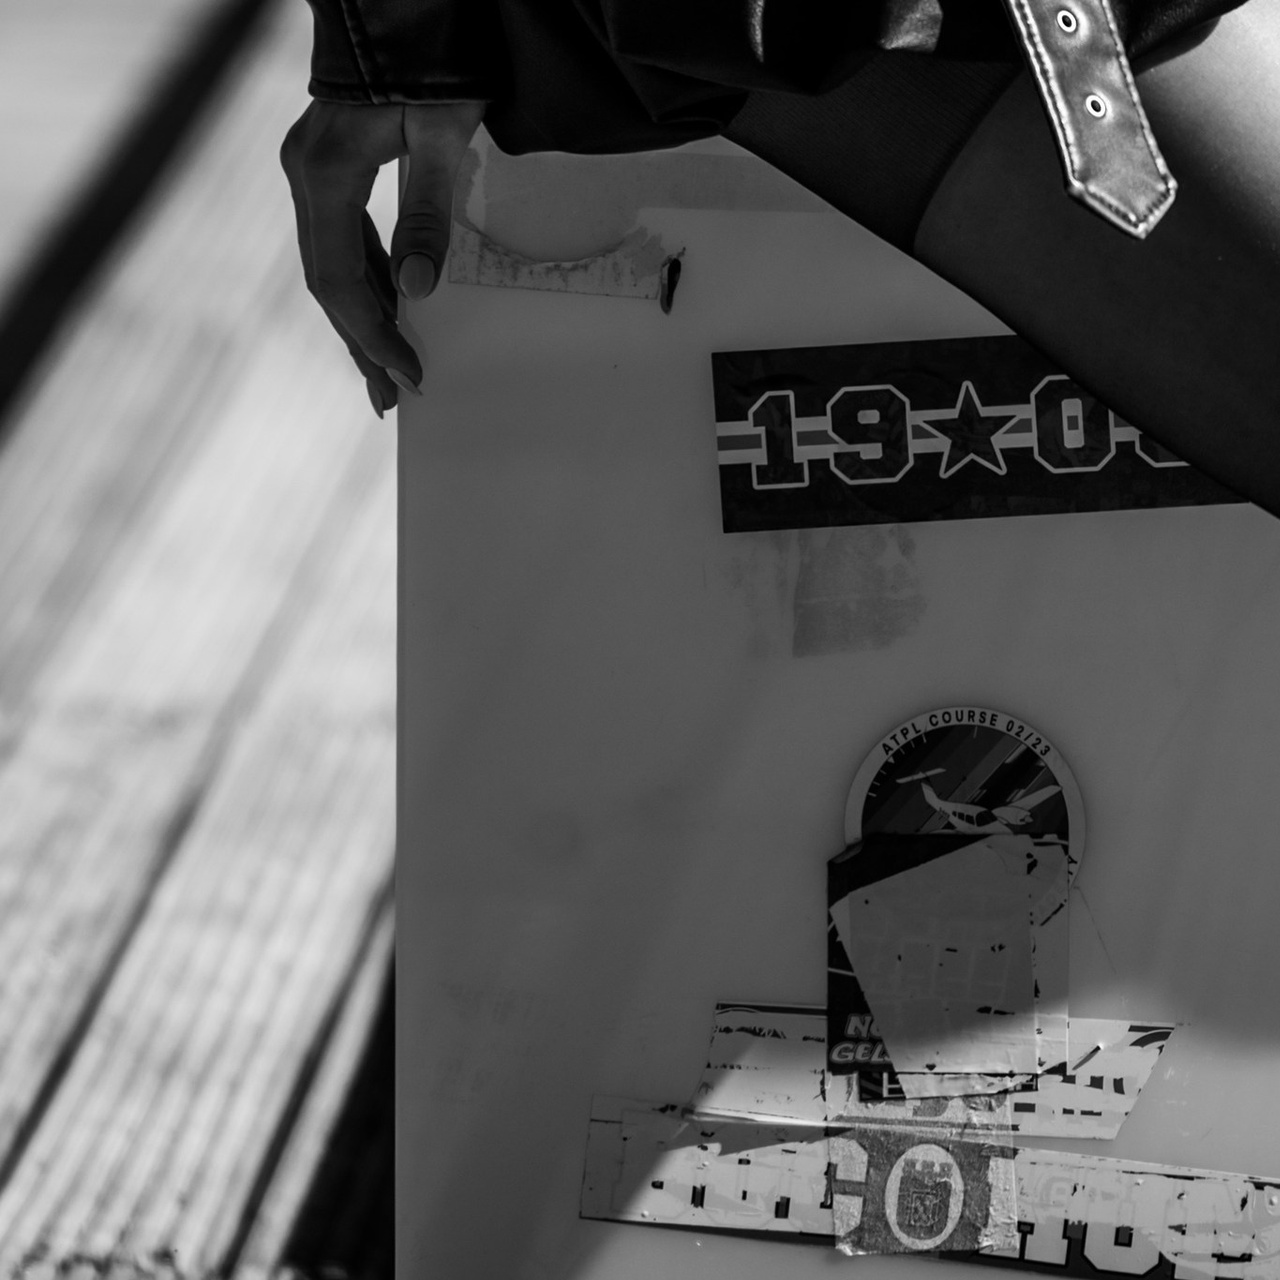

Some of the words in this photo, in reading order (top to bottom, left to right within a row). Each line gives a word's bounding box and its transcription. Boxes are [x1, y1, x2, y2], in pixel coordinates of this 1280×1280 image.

[881, 723, 922, 756] ATPL
[929, 709, 999, 727] COURSE
[1006, 719, 1051, 756] 02/23
[831, 1042, 893, 1063] GEL
